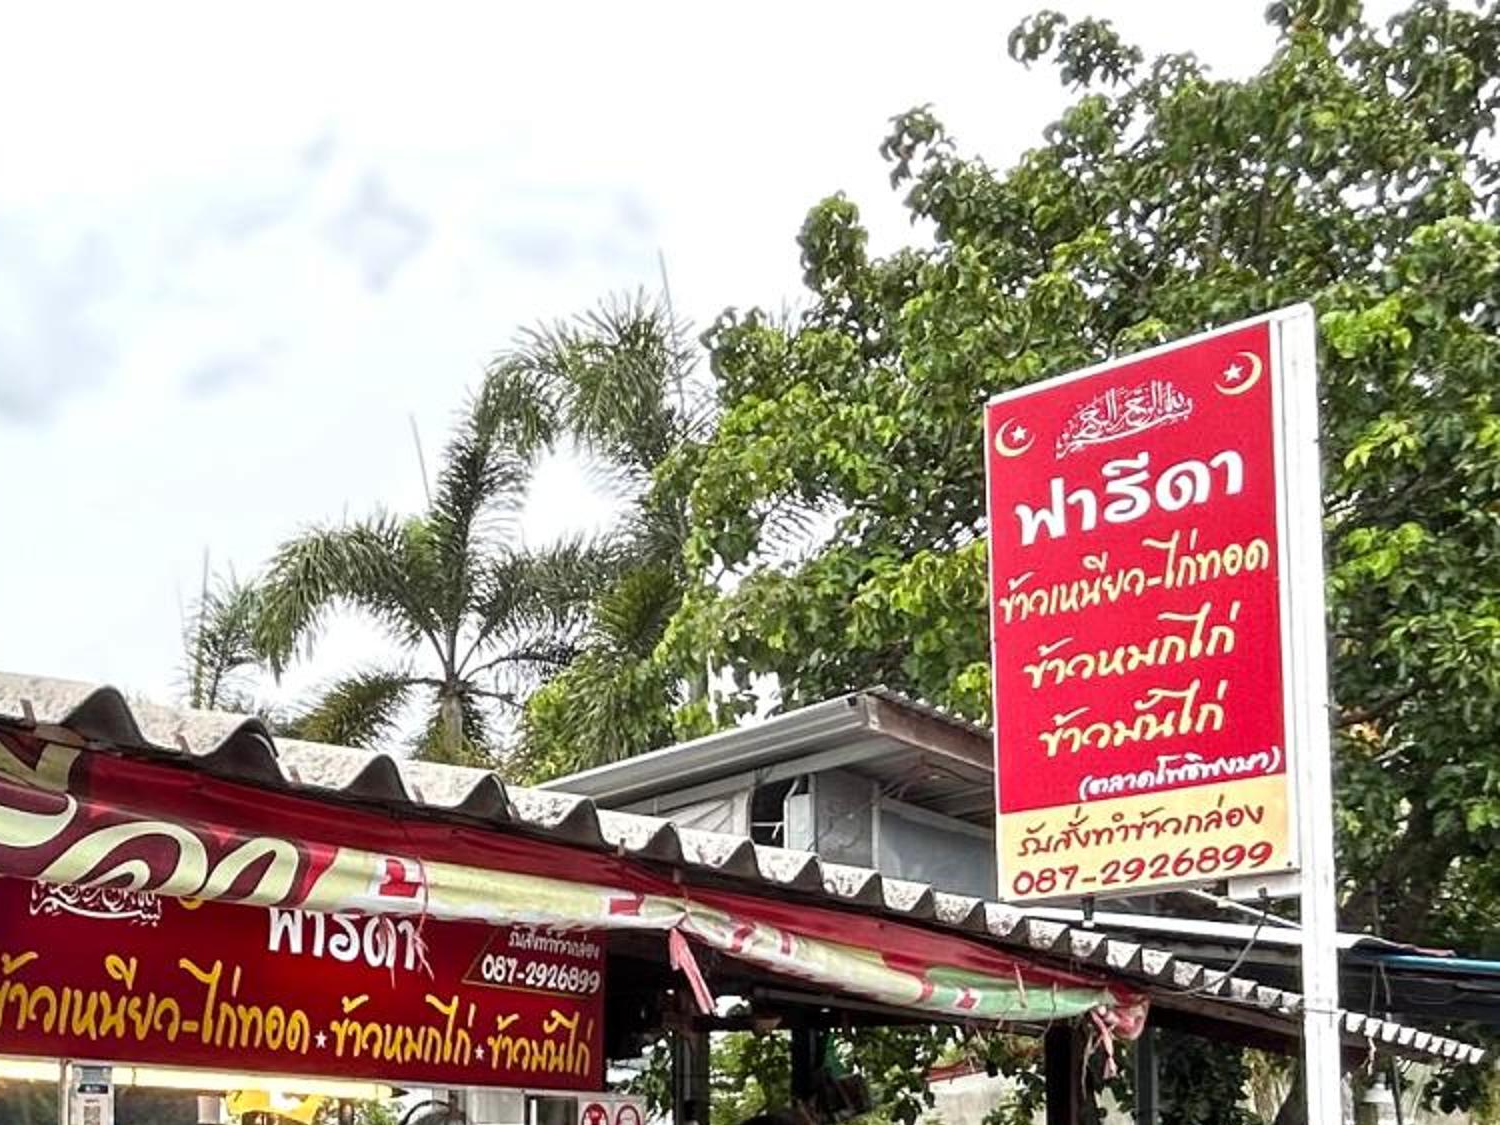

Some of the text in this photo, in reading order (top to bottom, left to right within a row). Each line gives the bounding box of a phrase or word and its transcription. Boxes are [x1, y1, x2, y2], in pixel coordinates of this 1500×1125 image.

[1015, 448, 1243, 547] ฟารีดา
[1024, 603, 1241, 689] ข้าวหมกไก่
[1039, 684, 1227, 757] ข้าวมันไก่
[1014, 841, 1273, 895] 087-2926899
[482, 953, 600, 994] 087-2926899
